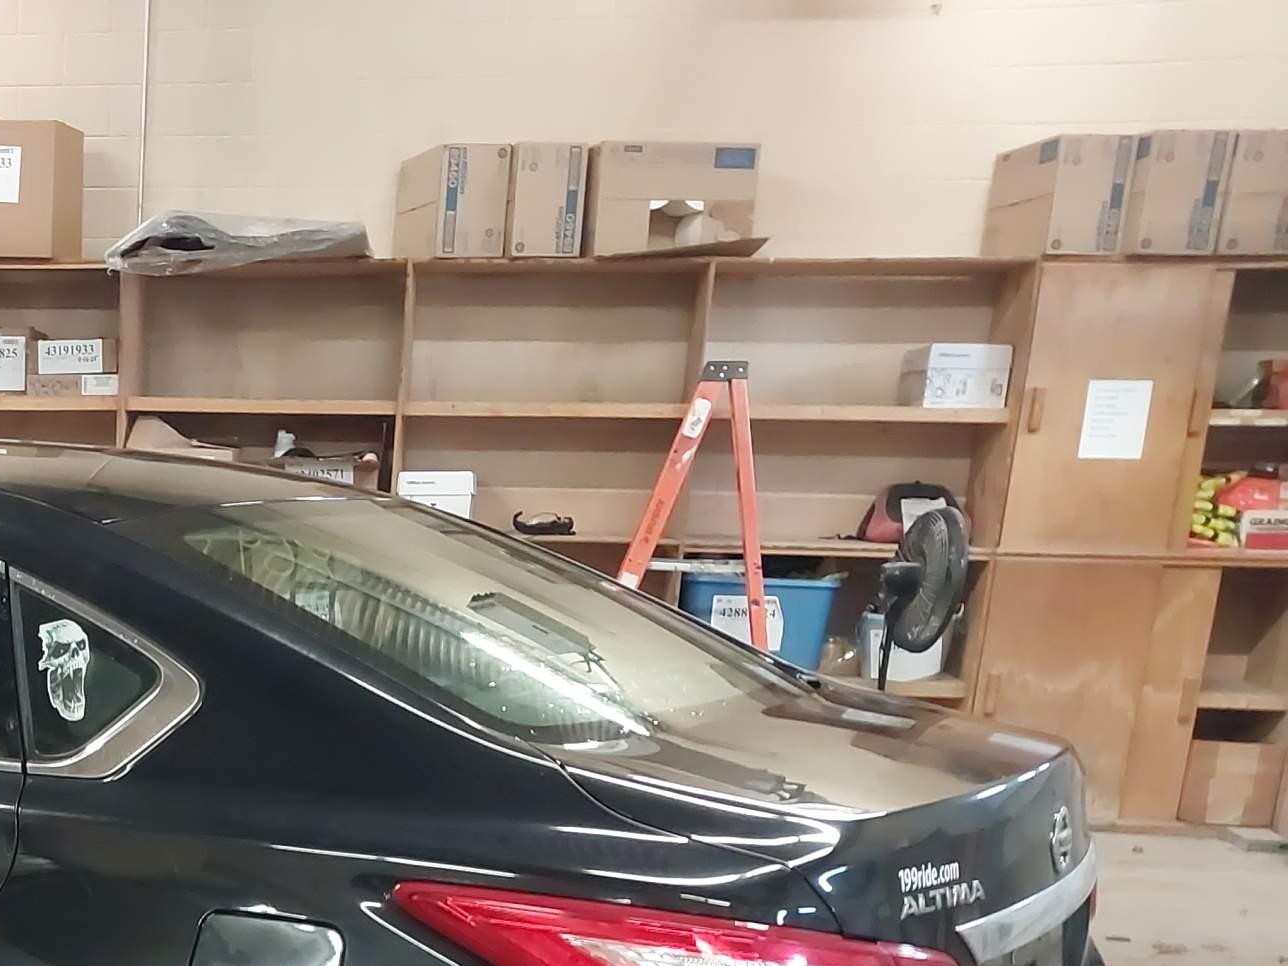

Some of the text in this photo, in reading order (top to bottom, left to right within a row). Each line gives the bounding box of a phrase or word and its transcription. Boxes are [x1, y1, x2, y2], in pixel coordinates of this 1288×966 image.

[44, 344, 95, 356] 43191933
[898, 862, 960, 893] 199ride.com
[900, 879, 986, 921] ALTIMA
